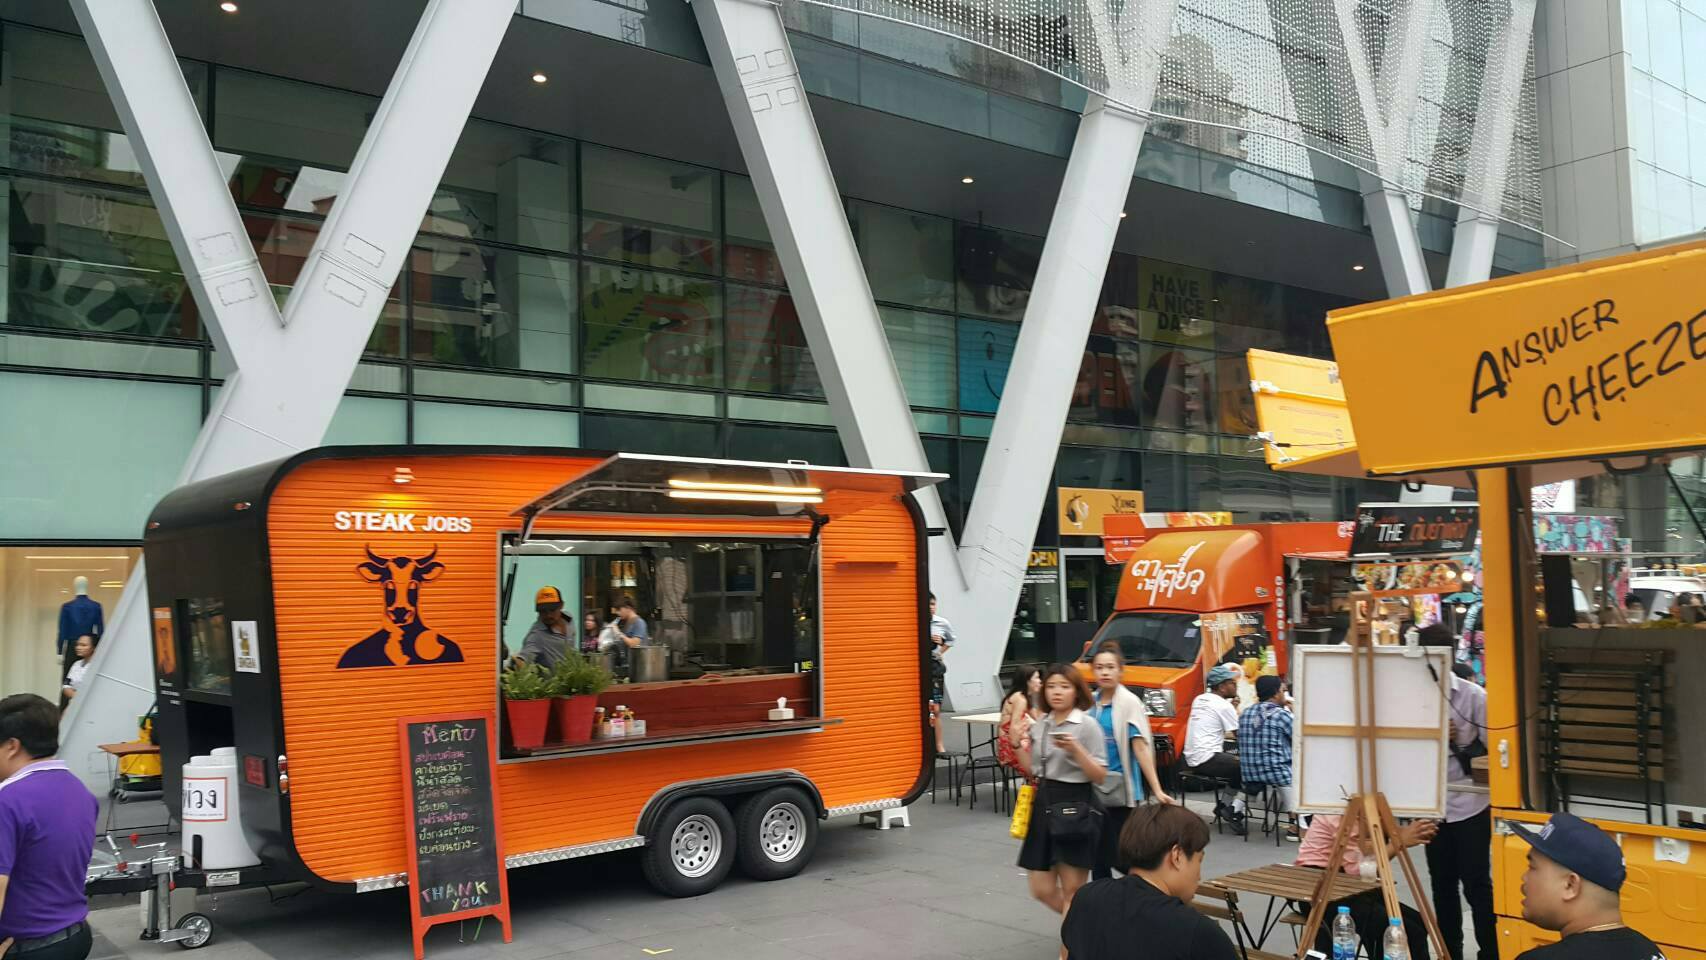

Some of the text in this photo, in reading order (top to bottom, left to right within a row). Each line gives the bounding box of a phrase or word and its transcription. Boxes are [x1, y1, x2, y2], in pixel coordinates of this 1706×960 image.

[1152, 273, 1200, 298] HAVE
[1148, 292, 1205, 318] A NICE
[334, 510, 473, 533] STEAK JOBS
[1378, 523, 1405, 542] THE
[421, 881, 488, 903] THANK
[452, 896, 481, 911] YOU
